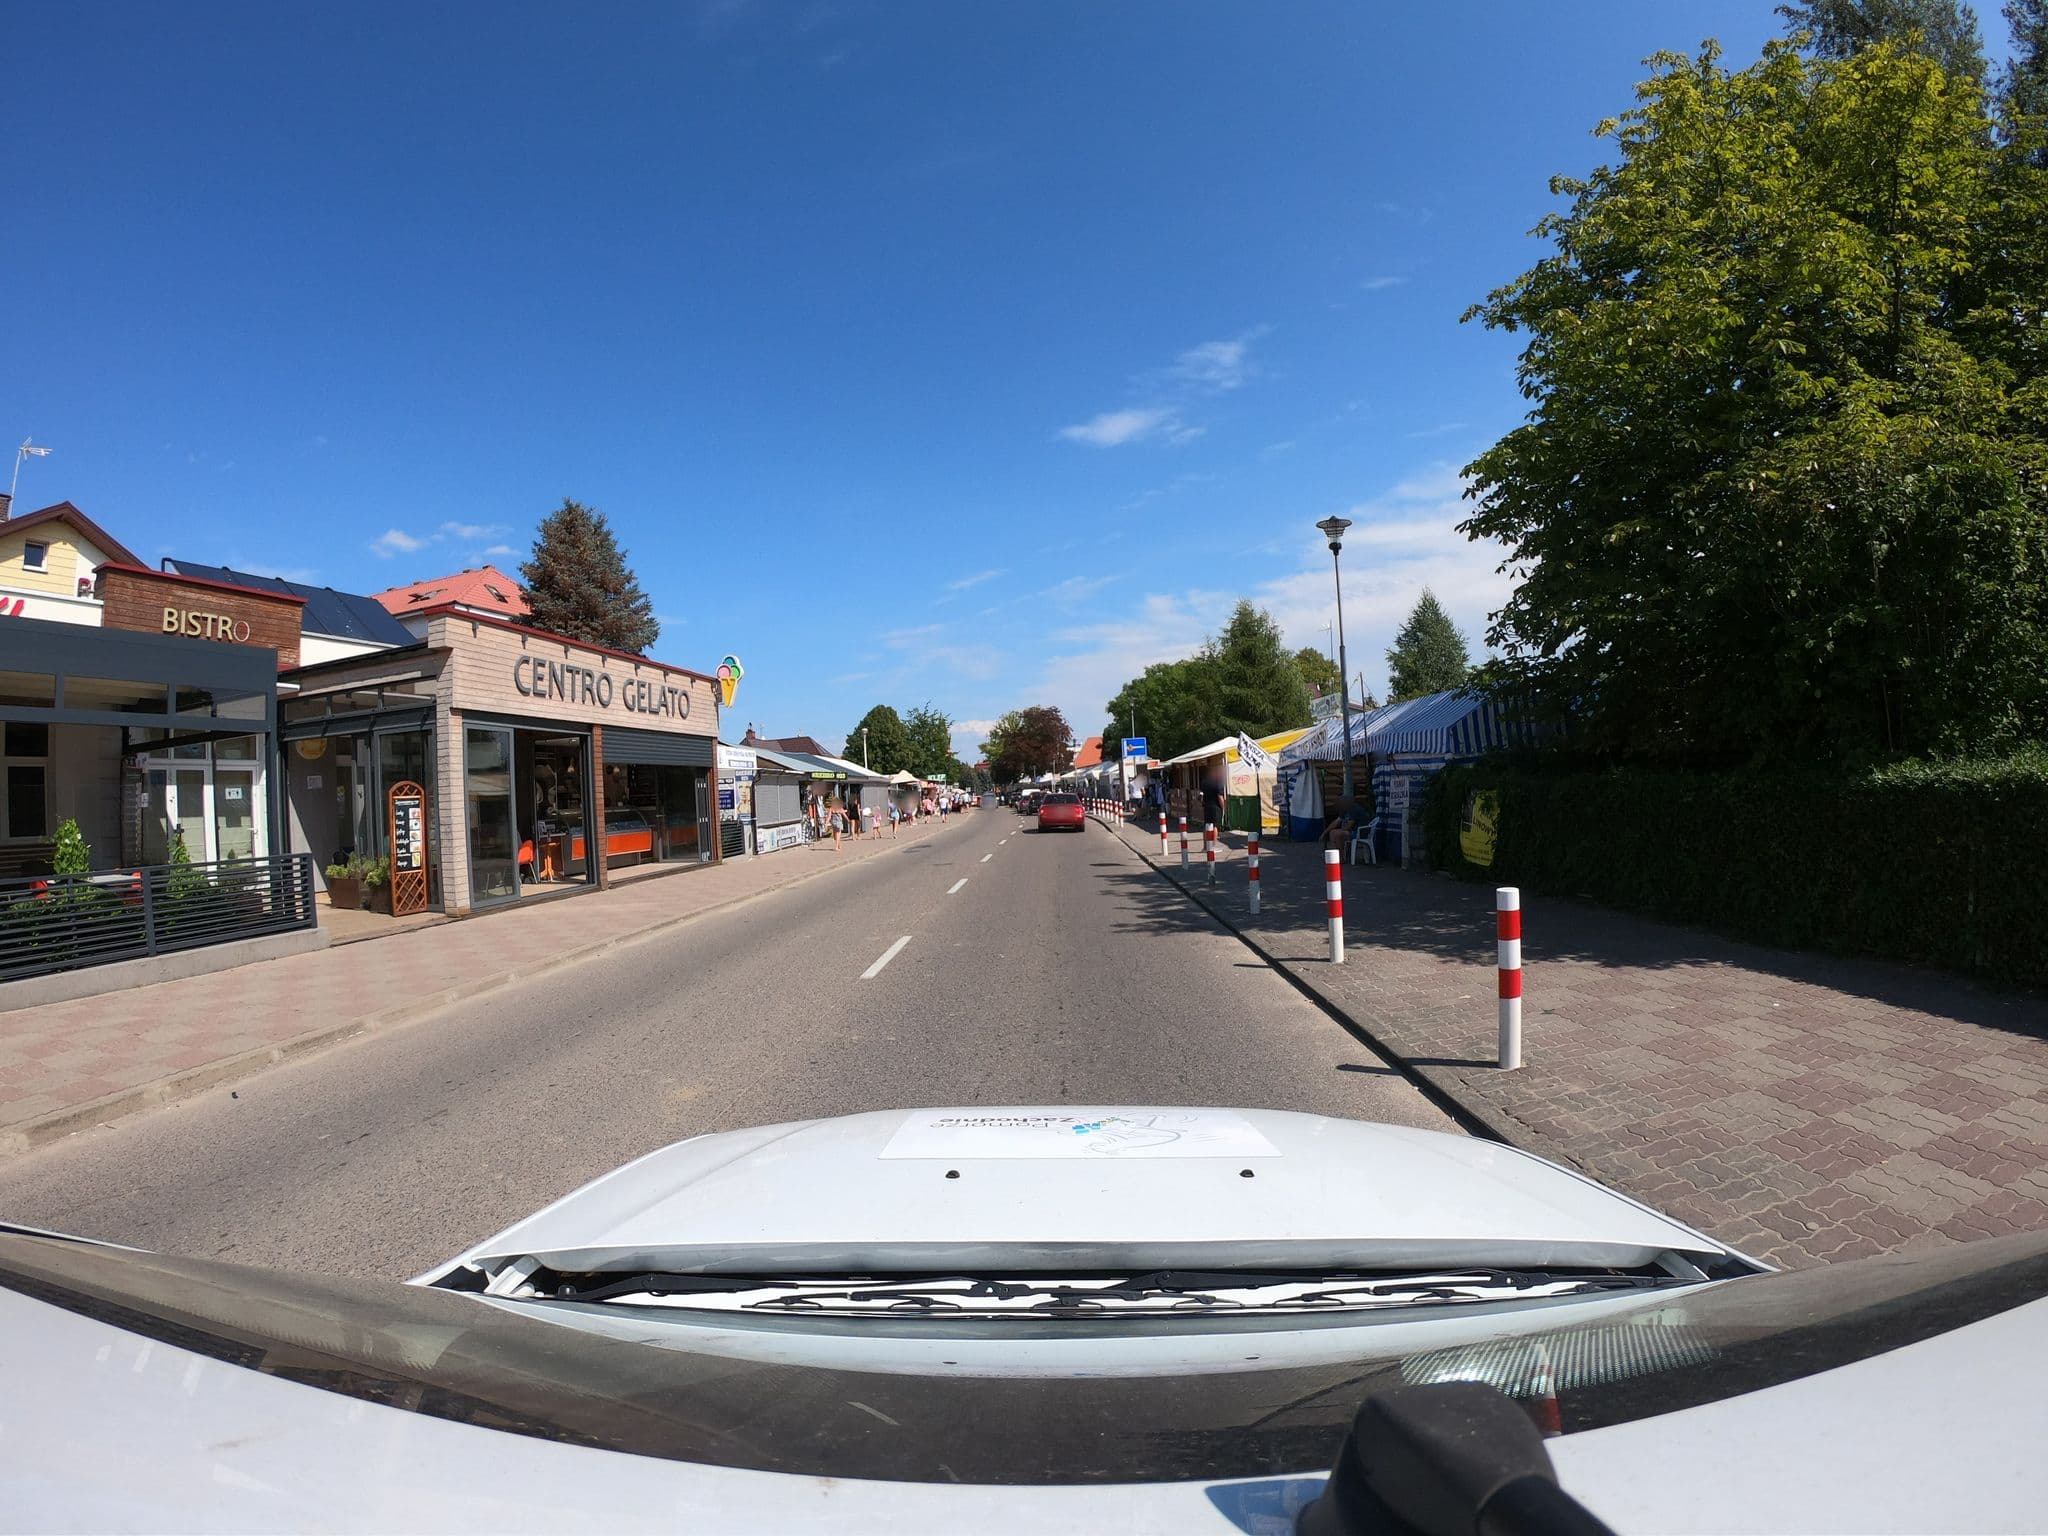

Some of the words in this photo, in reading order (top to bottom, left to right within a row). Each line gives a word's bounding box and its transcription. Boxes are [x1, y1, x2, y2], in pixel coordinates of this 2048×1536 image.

[162, 607, 250, 642] BISTRO
[514, 655, 613, 708] CENTRO
[622, 678, 691, 719] GELATO
